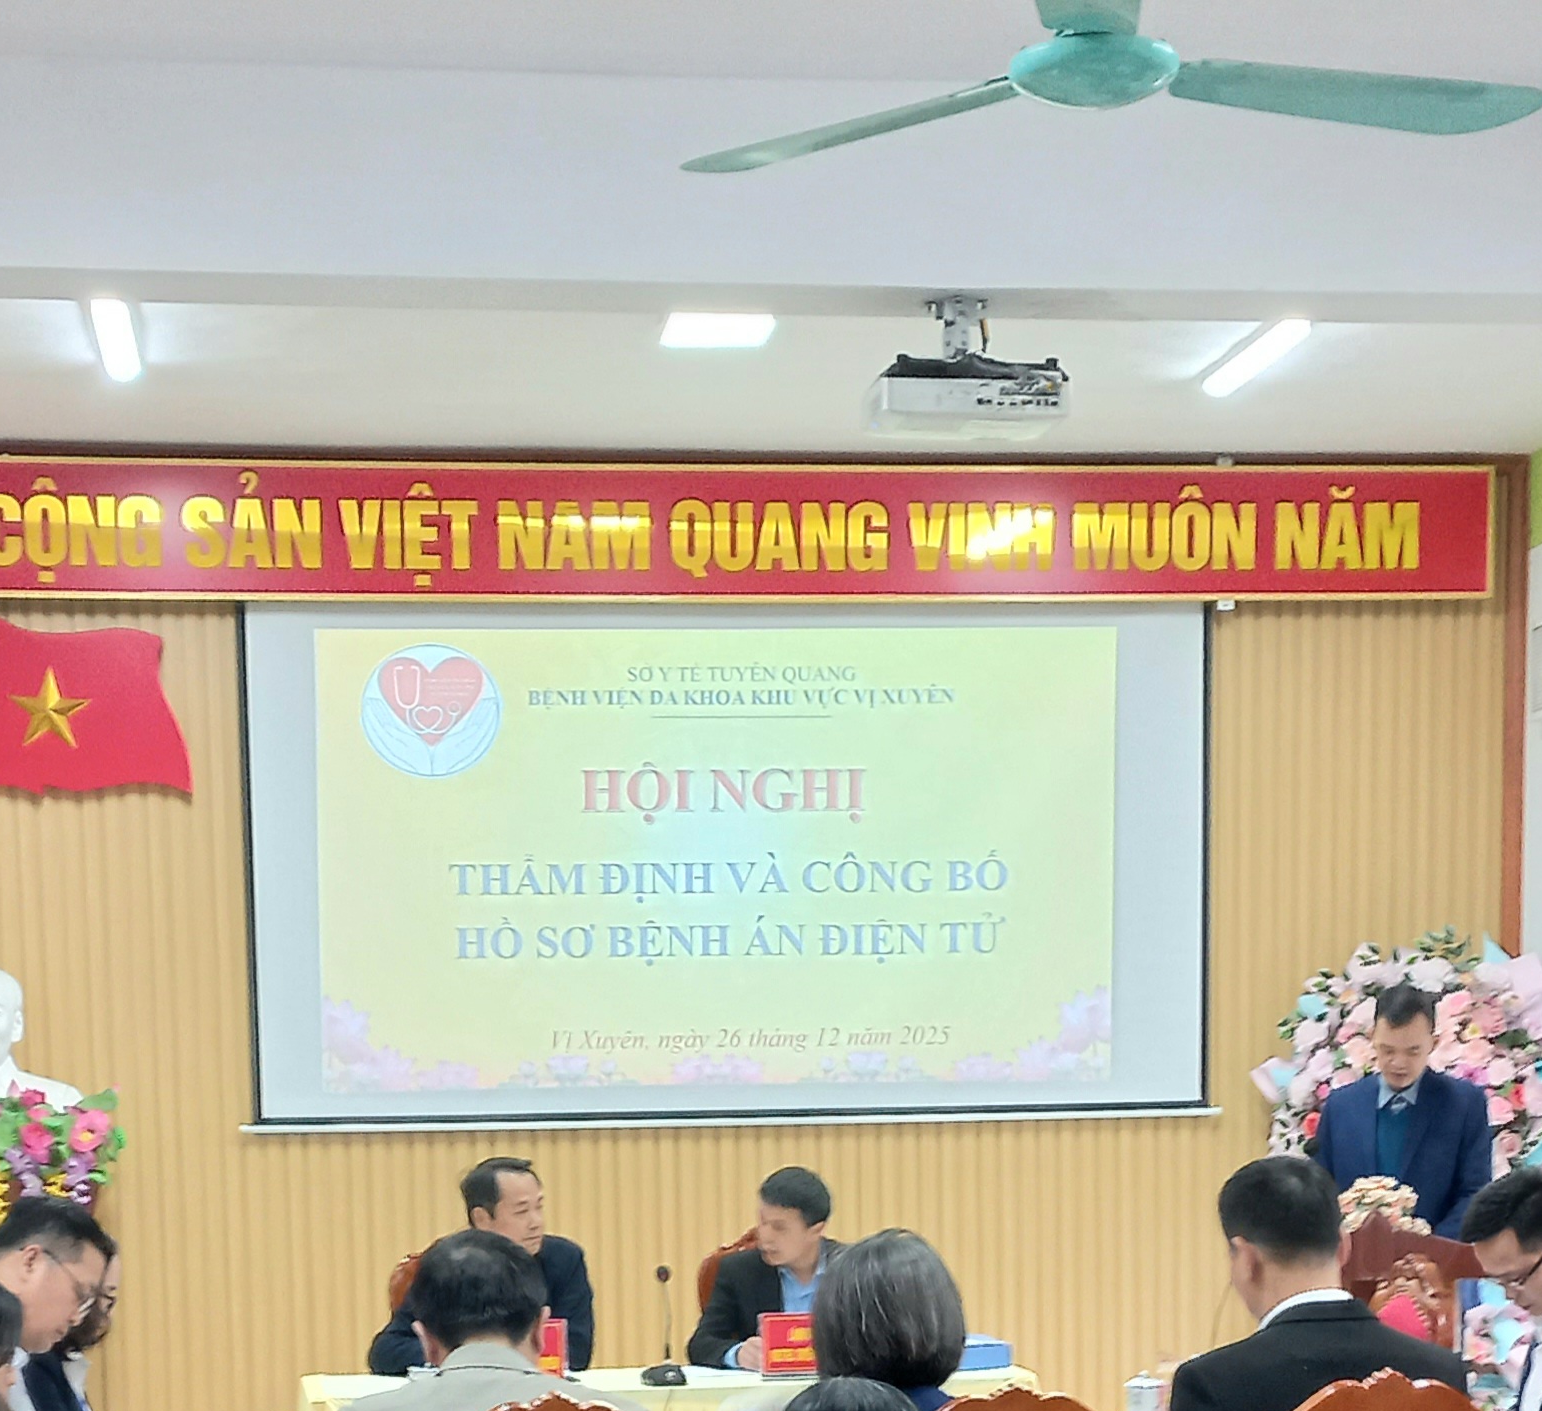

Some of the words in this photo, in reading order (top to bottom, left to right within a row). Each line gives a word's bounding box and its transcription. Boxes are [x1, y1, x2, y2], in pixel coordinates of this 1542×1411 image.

[181, 469, 323, 569] SẢN
[337, 481, 479, 587] VIỆT
[496, 499, 652, 571] NAM
[669, 496, 890, 578] QUANG
[908, 500, 1055, 572] VINH
[1071, 483, 1258, 572] MUÔN
[1273, 483, 1421, 572] NĂM
[527, 687, 587, 710] BỆNH
[592, 686, 644, 710] VIỆN
[683, 689, 745, 706] KHOA
[751, 688, 797, 706] KHU
[803, 686, 849, 709] VỰC
[854, 688, 876, 709] VỊ
[881, 683, 956, 705] XUYÊN
[658, 666, 672, 683] Y
[706, 661, 776, 683] TUYÊN
[782, 665, 857, 685] QUANG
[581, 761, 695, 825] HỘI
[709, 767, 867, 824] NGHỊ
[597, 861, 716, 904] ĐỊNH
[726, 851, 790, 893] VÀ
[802, 851, 933, 893] CÔNG
[947, 849, 1009, 892] BỐ
[456, 916, 524, 960] HỒ
[536, 923, 597, 959] SƠ
[607, 919, 731, 967] BỆNH
[743, 914, 807, 956] ÁN
[819, 918, 928, 965] ĐIỆN
[939, 911, 1007, 954] TỬ
[552, 1029, 573, 1053] Vị
[658, 1028, 711, 1054] ngày
[716, 1028, 742, 1048] 26
[748, 1028, 809, 1053] tháng
[816, 1027, 840, 1047] 12
[847, 1027, 892, 1047] năm
[899, 1025, 952, 1046] 2025
